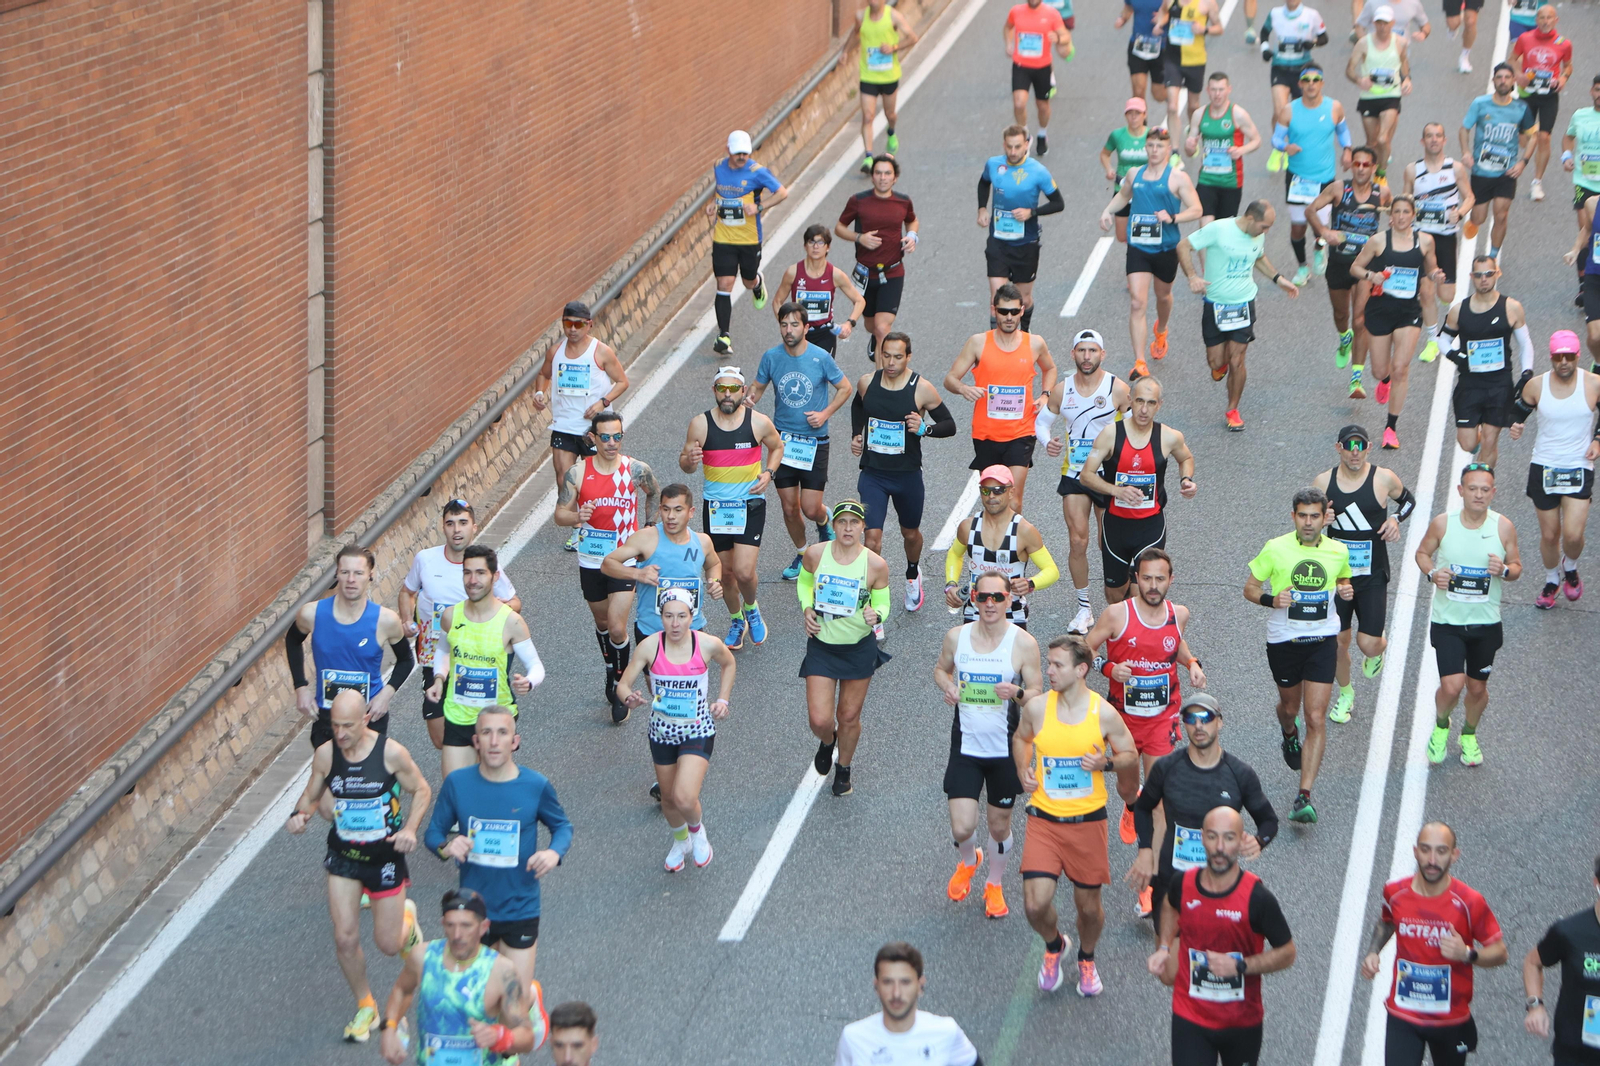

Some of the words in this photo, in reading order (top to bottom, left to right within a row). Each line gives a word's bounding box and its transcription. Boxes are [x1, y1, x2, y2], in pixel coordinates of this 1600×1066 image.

[782, 373, 807, 384] MOUNTAIN
[784, 398, 808, 408] COACHING
[794, 436, 814, 445] ZURICH
[1130, 476, 1152, 484] ZURICH
[594, 497, 631, 509] MONACO
[590, 531, 613, 539] ZURICH
[831, 579, 855, 587] ZURICH
[1294, 573, 1325, 584] sherry
[463, 652, 496, 664] Running
[468, 670, 493, 678] ZURICH
[972, 675, 998, 683] ZURICH
[655, 679, 698, 690] ENTRENA
[667, 690, 693, 698] ZURICH
[1139, 691, 1155, 699] 2912
[484, 823, 513, 832] ZURICH
[1413, 967, 1444, 977] ZURICH
[444, 1040, 478, 1049] ZURICH
